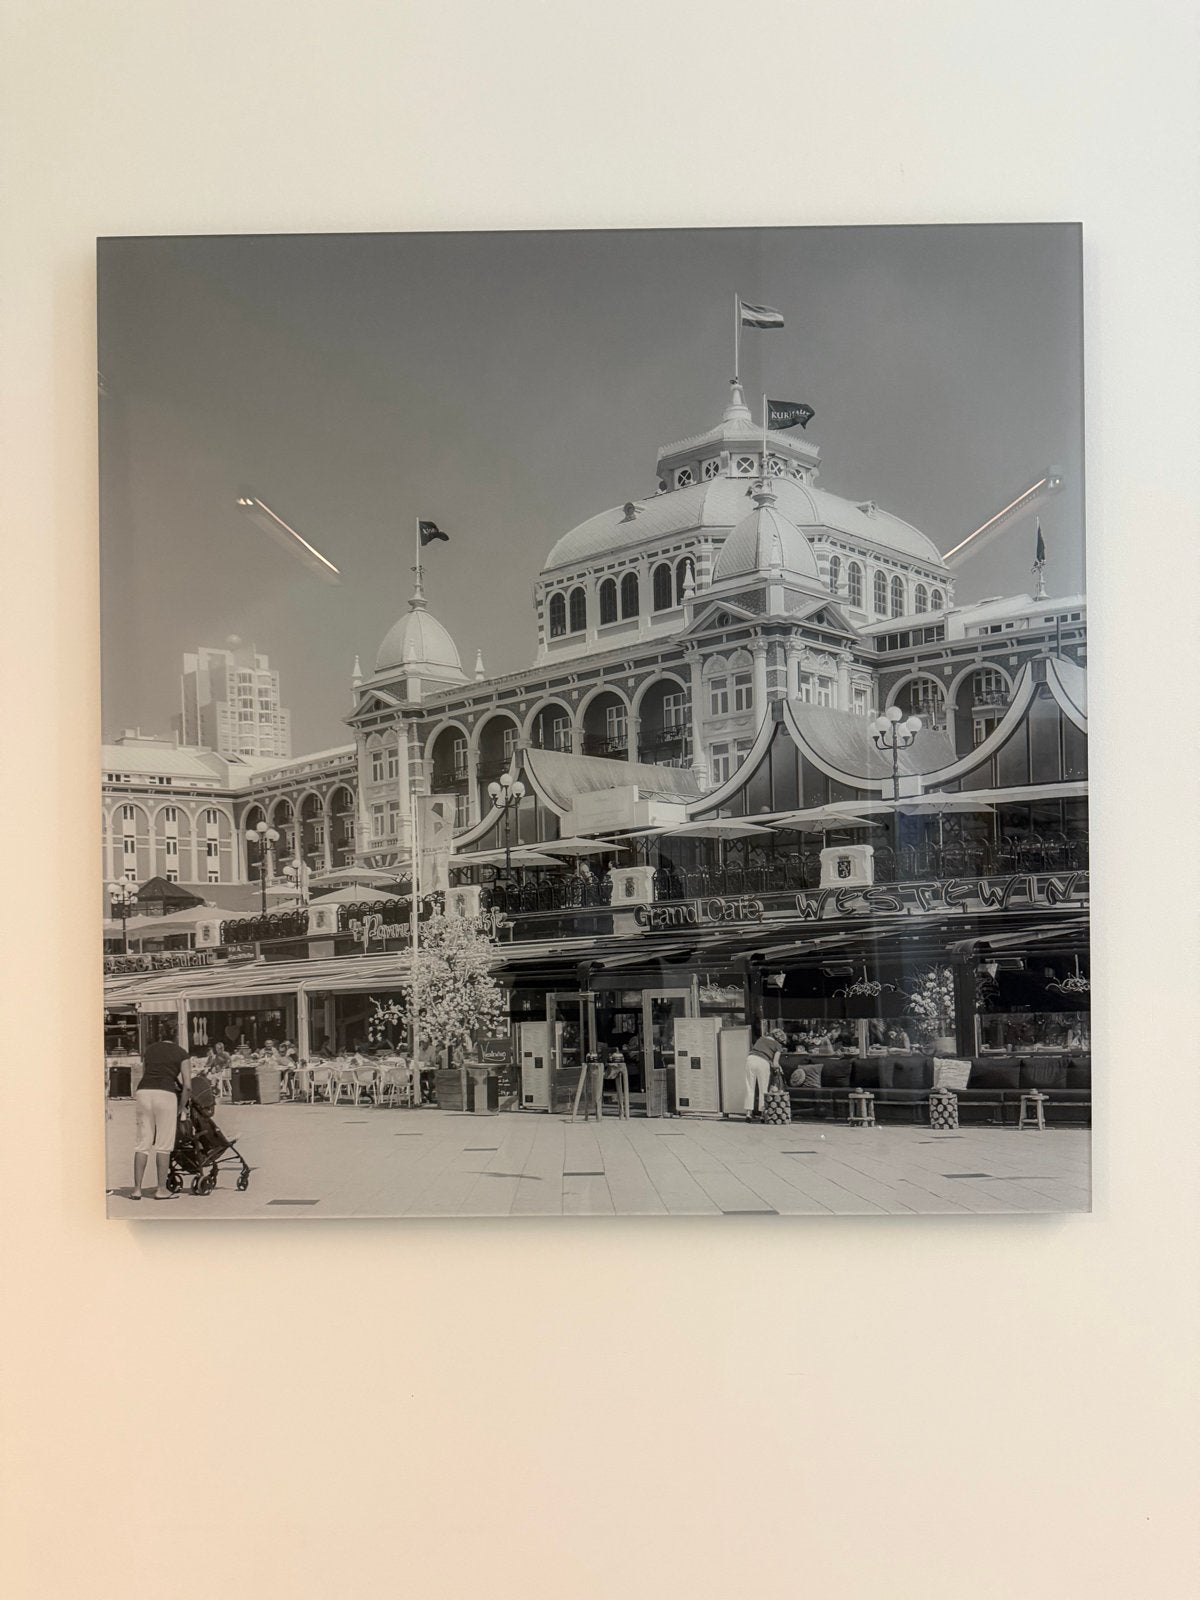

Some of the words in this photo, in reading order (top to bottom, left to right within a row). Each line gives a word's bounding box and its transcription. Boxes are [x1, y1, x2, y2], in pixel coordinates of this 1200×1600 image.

[634, 903, 701, 927] Grand
[707, 895, 764, 921] Café
[796, 872, 1089, 919] WESTEWIN
